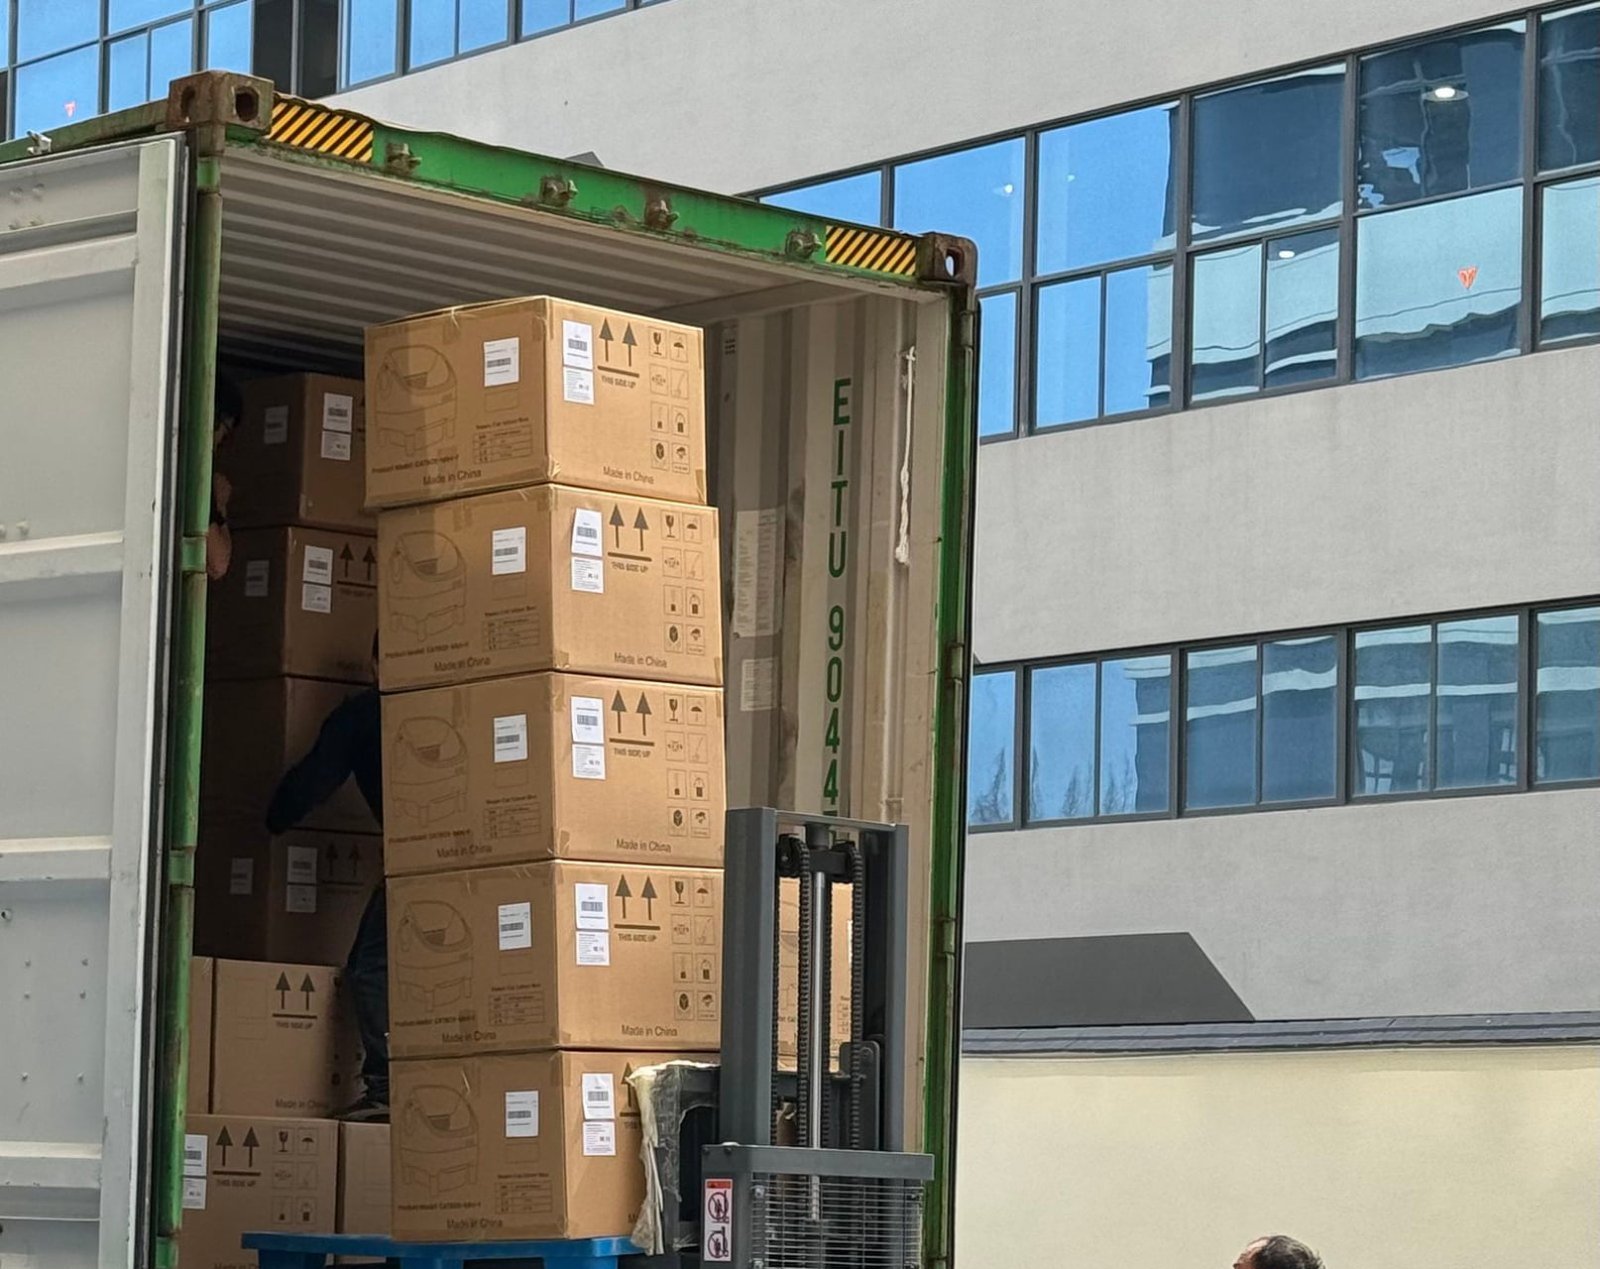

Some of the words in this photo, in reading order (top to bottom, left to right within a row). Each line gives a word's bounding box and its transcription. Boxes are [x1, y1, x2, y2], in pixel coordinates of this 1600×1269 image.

[423, 474, 446, 485] Made
[448, 472, 456, 482] in
[457, 469, 482, 480] China
[603, 466, 624, 479] Made
[625, 470, 632, 480] in
[633, 471, 655, 484] China
[828, 378, 852, 578] EITU
[614, 652, 635, 665] Made
[637, 655, 644, 665] in
[645, 656, 667, 668] China
[822, 605, 844, 816] 9044
[616, 838, 638, 850] Made
[640, 841, 647, 851] in
[648, 841, 671, 853] China
[621, 1025, 644, 1036] Made
[646, 1027, 653, 1036] in
[655, 1026, 678, 1037] China
